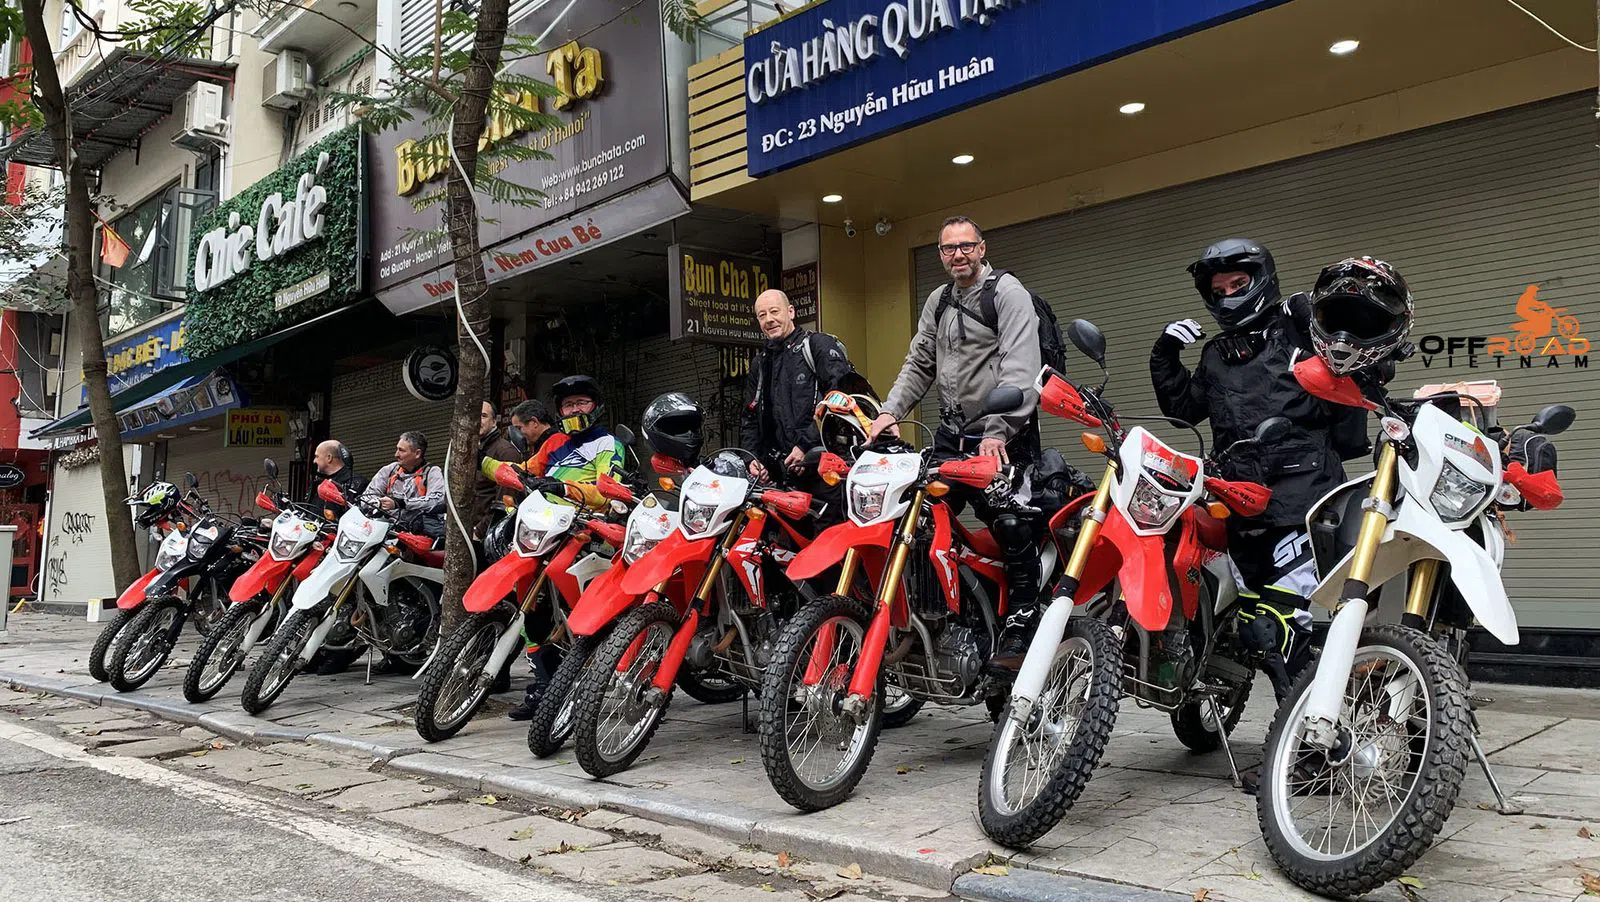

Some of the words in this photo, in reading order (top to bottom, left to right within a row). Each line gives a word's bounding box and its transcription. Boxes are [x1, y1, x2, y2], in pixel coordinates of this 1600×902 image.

[546, 39, 604, 112] Ta
[748, 41, 803, 104] CỬA
[801, 19, 880, 84] HÀNG
[762, 131, 793, 153] ĐC:
[797, 120, 817, 141] 23
[820, 91, 887, 134] Nguyễn
[892, 77, 933, 107] Hữu
[938, 55, 995, 89] Huân
[541, 128, 555, 152] of
[541, 133, 646, 189] Web:www.bunchata.com
[575, 181, 592, 198] 942
[591, 174, 608, 192] 269
[608, 164, 624, 183] 122
[256, 152, 330, 261] Café
[422, 280, 456, 297] Bun
[494, 249, 538, 273] Nem
[536, 236, 573, 256] Cua
[684, 254, 715, 295] Bun
[719, 260, 749, 299] Cha
[753, 265, 769, 297] Ta
[687, 319, 699, 333] 21
[702, 326, 728, 337] NGUYEN
[711, 299, 729, 311] food
[729, 303, 739, 312] at
[720, 314, 729, 324] of
[0, 468, 19, 481] alog
